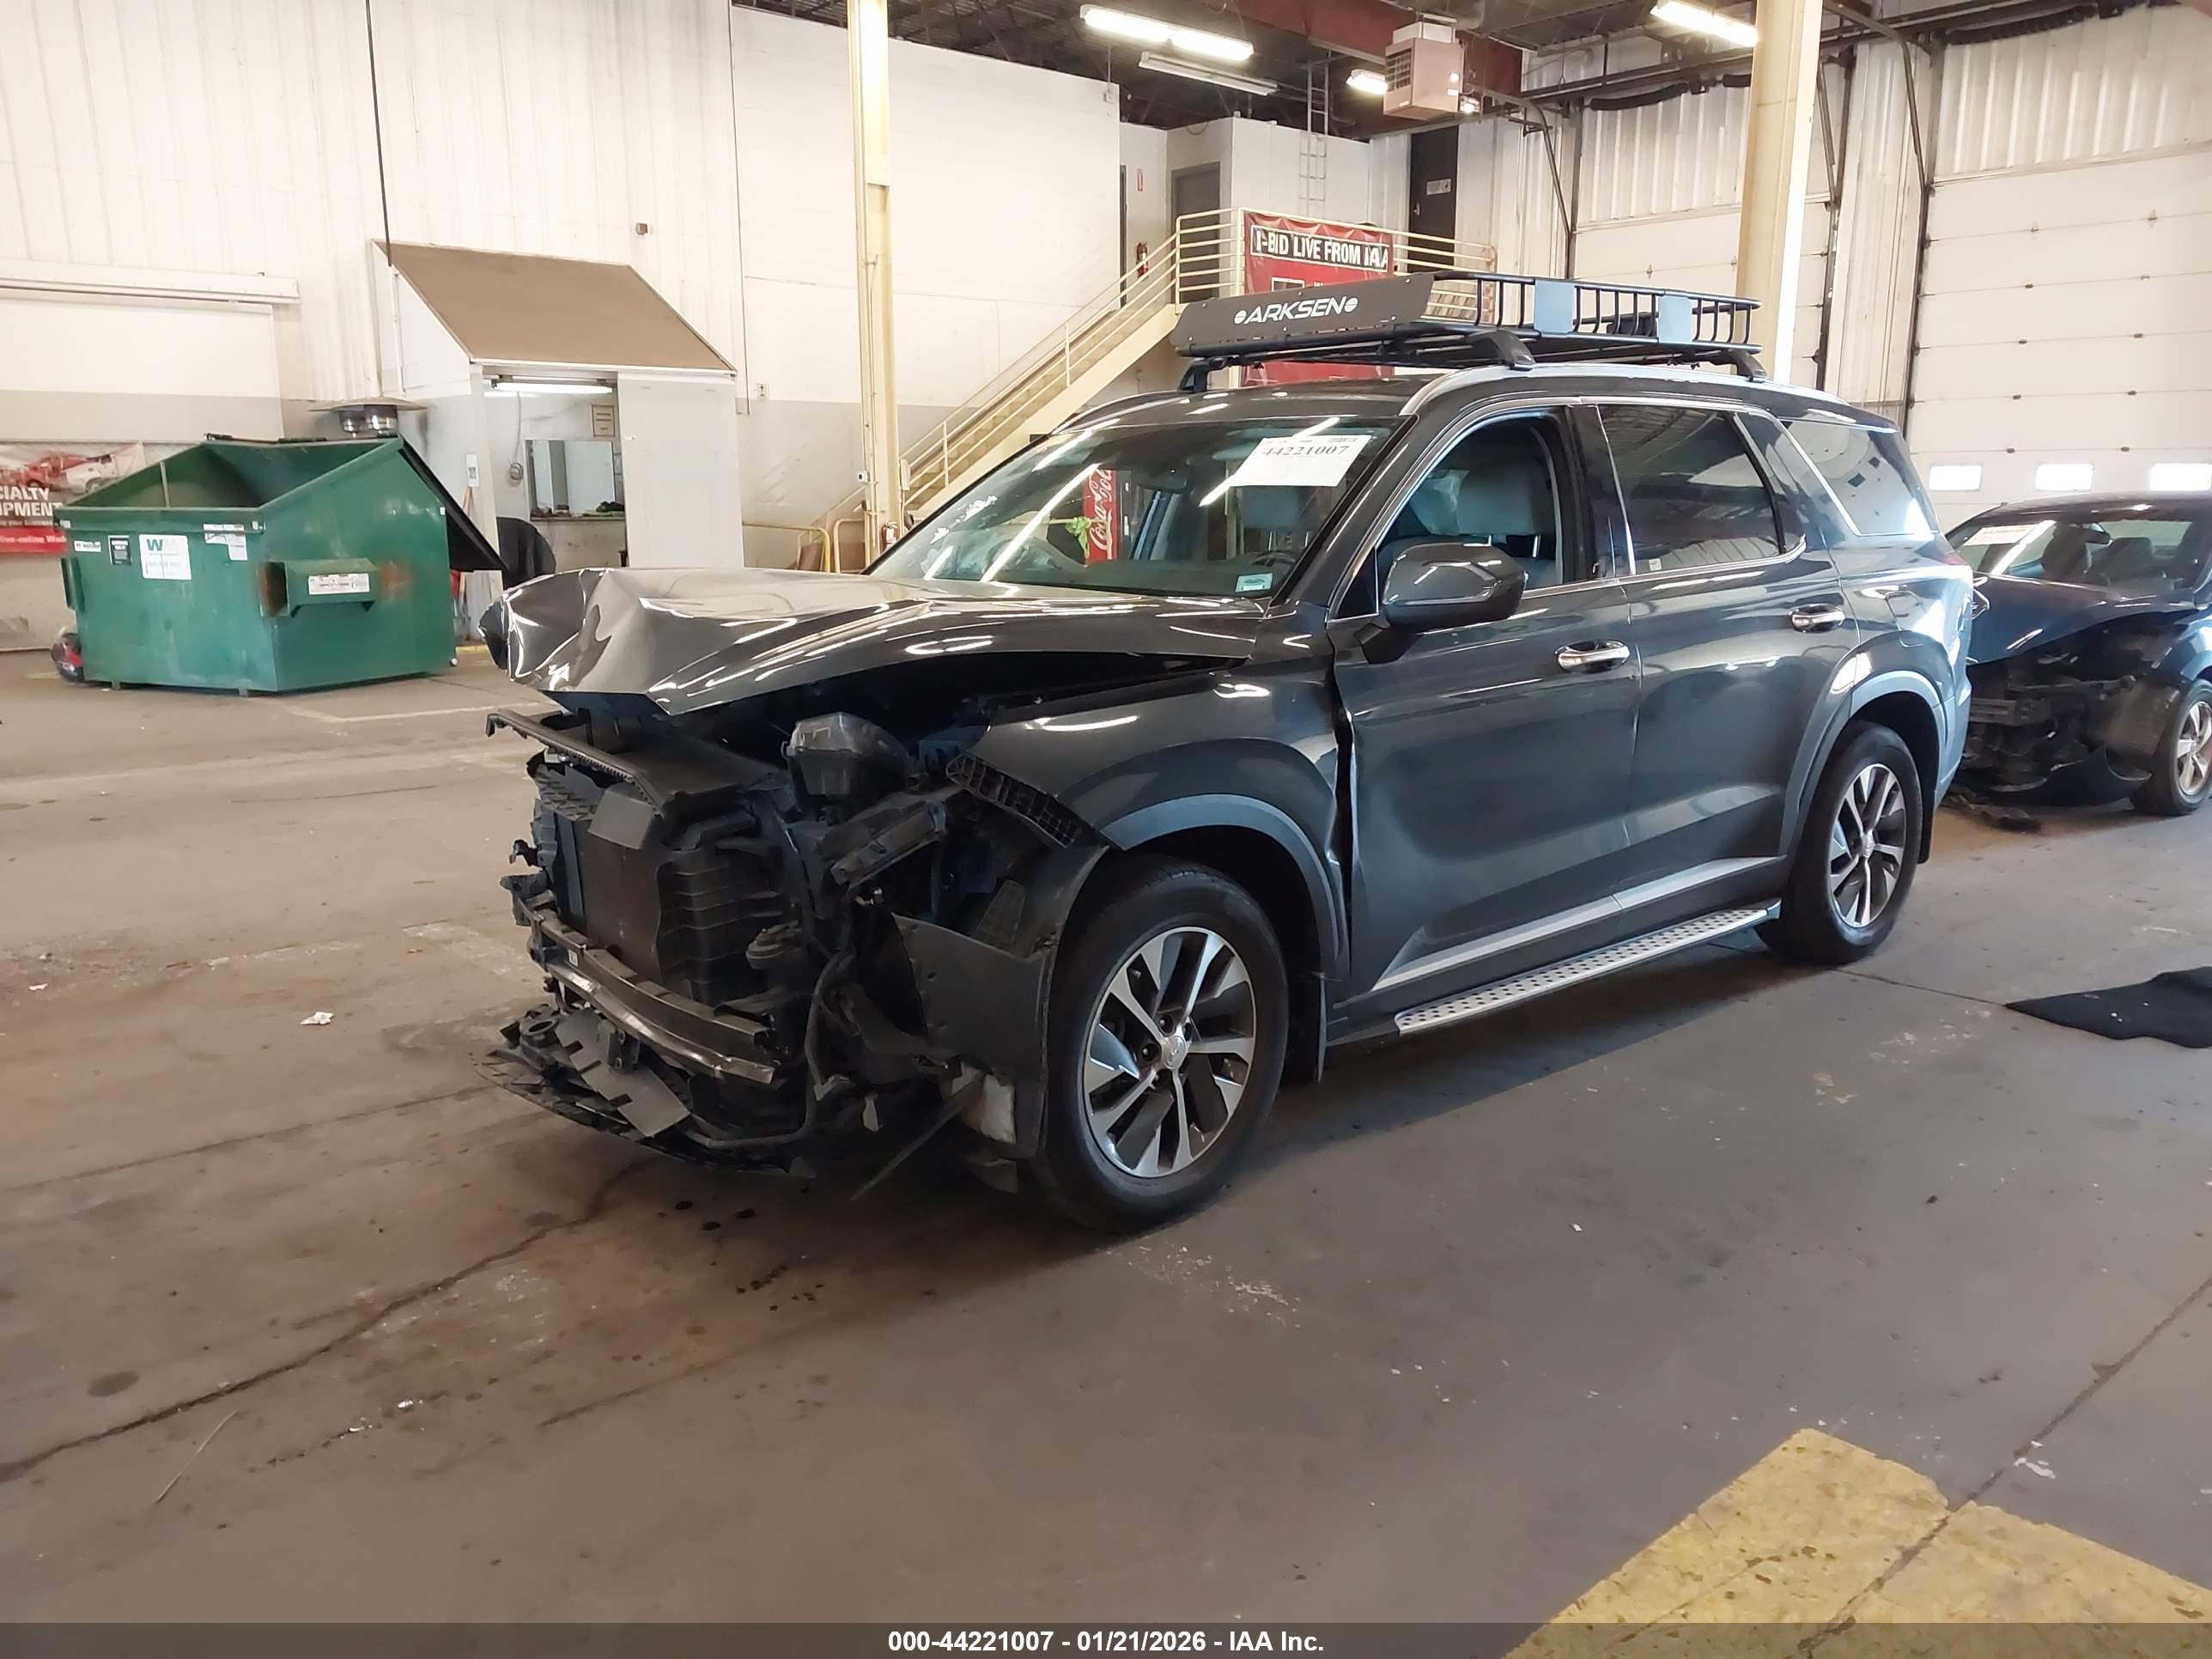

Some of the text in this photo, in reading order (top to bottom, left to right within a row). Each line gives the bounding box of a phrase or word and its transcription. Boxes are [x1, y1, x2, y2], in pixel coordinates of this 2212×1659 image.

[1255, 230, 1289, 255] I-BID
[1293, 235, 1322, 259] LIVE
[1324, 240, 1361, 264] FROM
[1243, 295, 1347, 325] ARKSEN
[1262, 445, 1350, 456] 44221007
